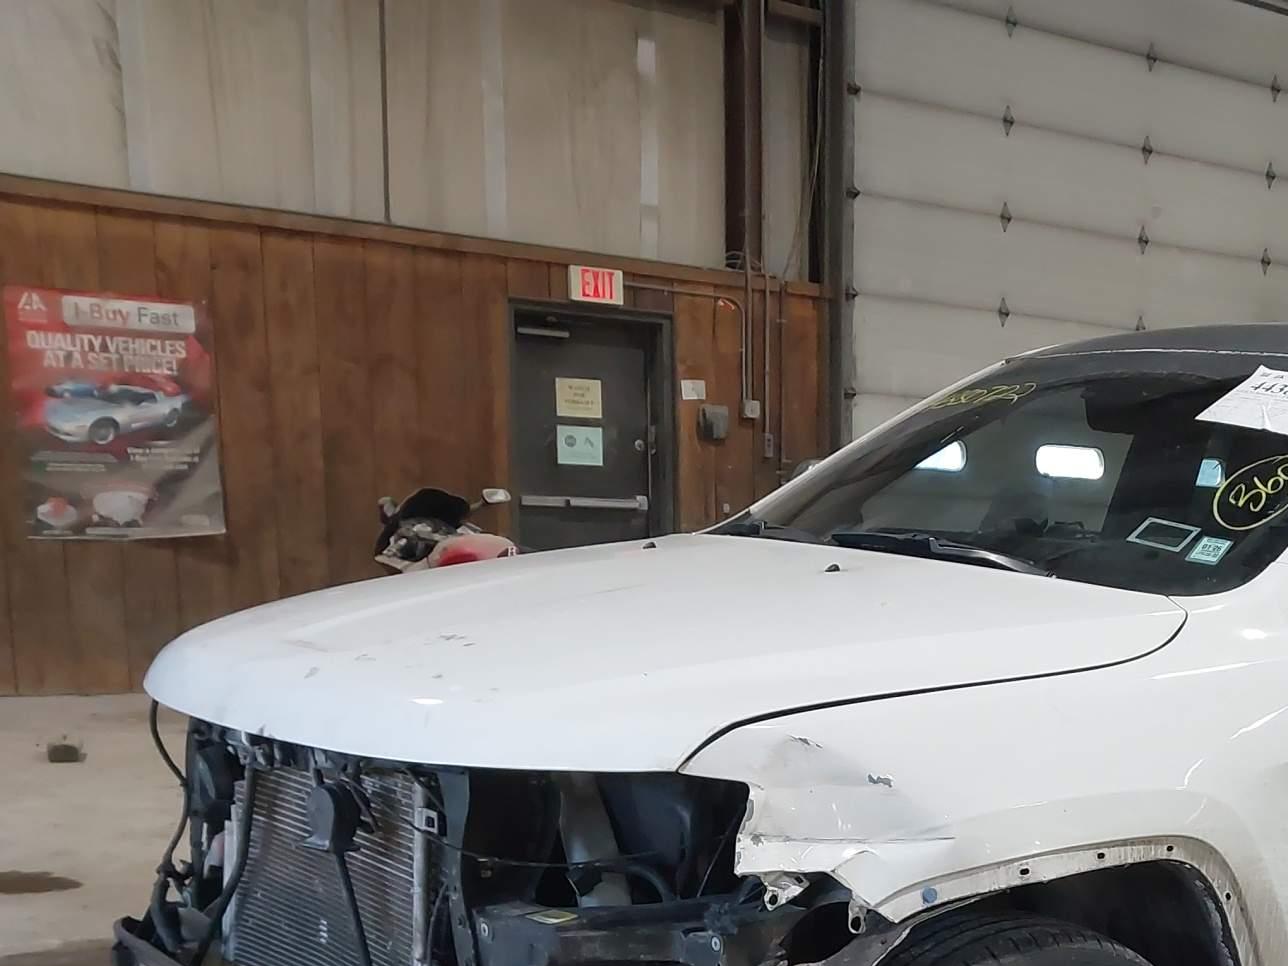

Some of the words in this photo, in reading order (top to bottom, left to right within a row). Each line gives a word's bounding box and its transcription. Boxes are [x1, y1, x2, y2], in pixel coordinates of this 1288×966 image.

[580, 268, 615, 300] EXIT
[137, 306, 181, 327] Fast
[26, 330, 102, 353] QUALITY
[105, 335, 187, 358] VEHICLES
[43, 350, 67, 368] AT
[70, 351, 85, 370] A
[87, 352, 120, 372] SET
